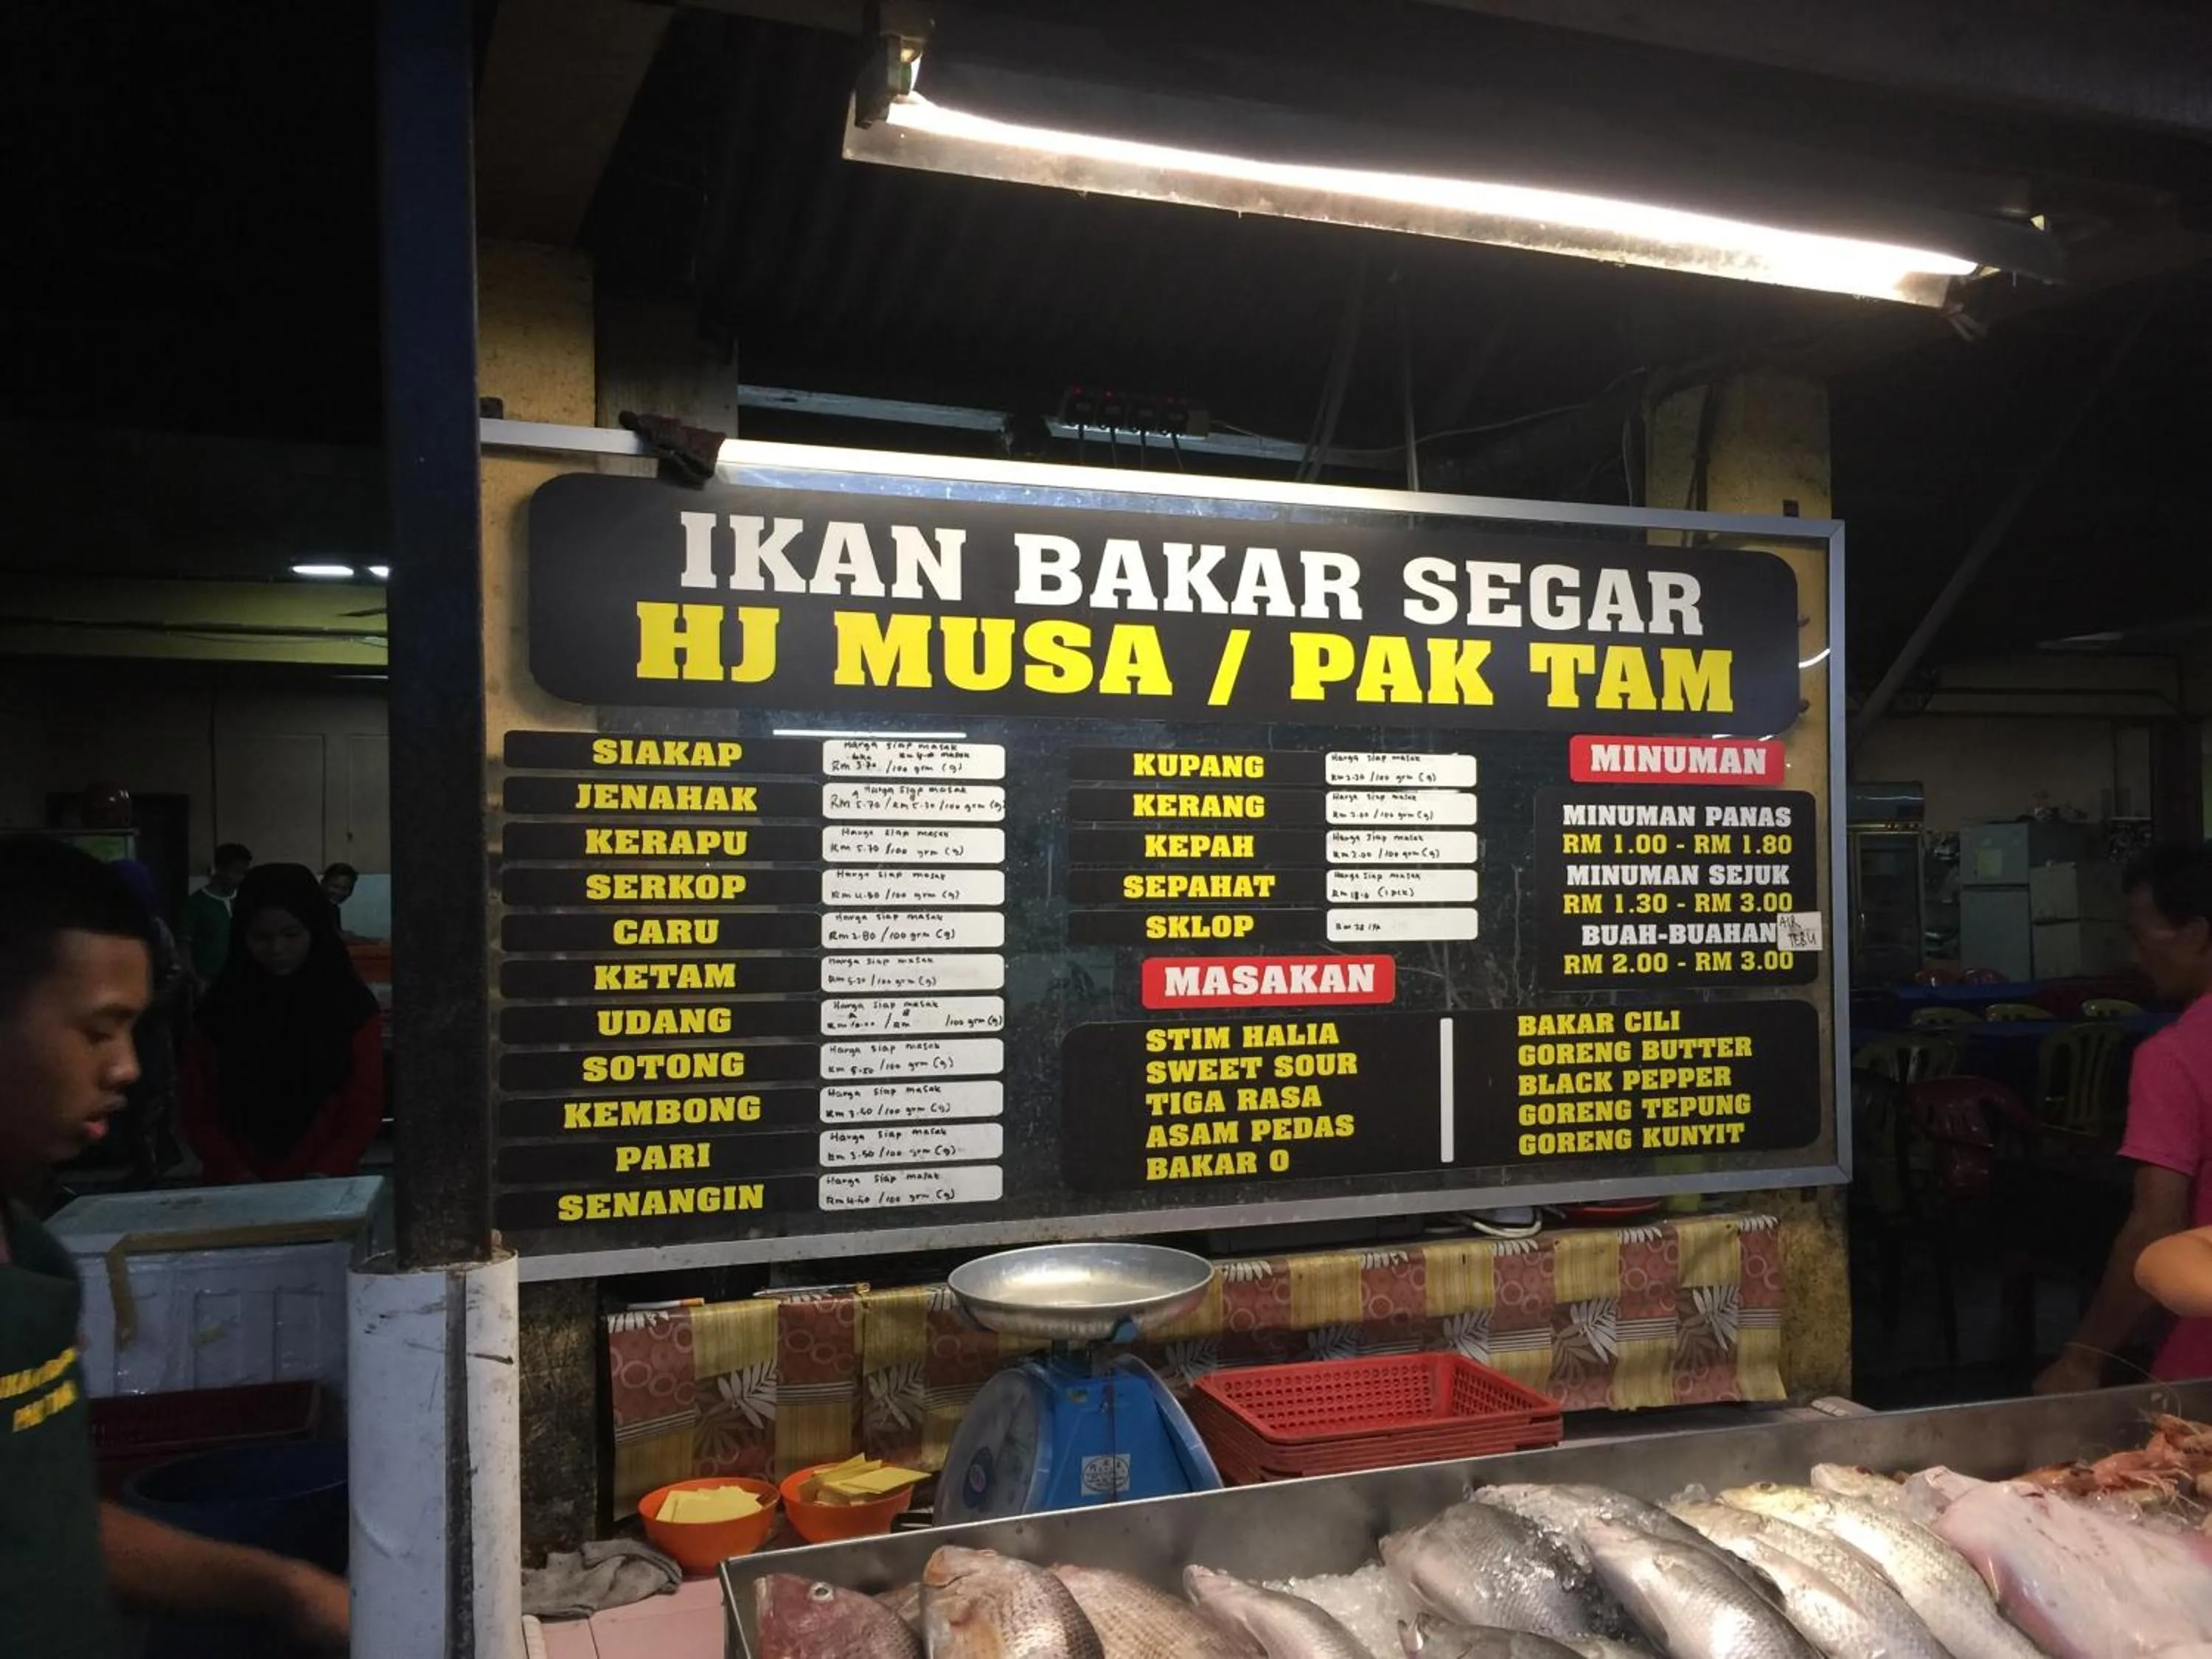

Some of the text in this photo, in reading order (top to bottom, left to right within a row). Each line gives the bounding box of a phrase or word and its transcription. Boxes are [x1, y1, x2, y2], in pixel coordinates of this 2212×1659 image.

[681, 511, 1703, 636] IKAN BAKAR SEGAR
[636, 601, 1733, 713] HJ MUSA / PAK TAM
[592, 738, 742, 768] SIAKAP
[1133, 752, 1265, 779] KUPANG
[1590, 744, 1766, 774] MINUMAN
[575, 783, 757, 812] JENAHAK
[1132, 793, 1265, 818] KERANG
[1562, 804, 1791, 827] MINUMAN PANAS
[585, 828, 748, 856] KERAPU
[1144, 834, 1255, 858] KEPAH
[1563, 833, 1602, 854] RM
[1615, 833, 1667, 855] 1.00
[1694, 834, 1731, 855] RM
[1743, 834, 1792, 855] 1.80
[586, 874, 747, 900] SERKOP
[1123, 874, 1276, 899] SEPAHAT
[1567, 864, 1790, 886] MINUMAN SEJUK
[1563, 893, 1603, 914] RM
[1615, 893, 1668, 914] 1.30
[1695, 893, 1732, 913] RM
[1740, 892, 1792, 913] 3.00
[613, 919, 720, 945] CARU
[1145, 914, 1254, 939] SKLOP
[1582, 922, 1776, 946] BUAH-BUAHAN
[594, 963, 736, 990] KETAM
[1564, 953, 1603, 975] RM
[1612, 952, 1668, 974] 2.00
[1695, 951, 1732, 971] RM
[1740, 950, 1793, 971] 3.00
[1164, 964, 1375, 996] MASAKAN
[597, 1007, 731, 1036] UDANG
[1517, 1010, 1680, 1037] BAKAR CILI
[1145, 1022, 1340, 1053] STIM HALIA
[1518, 1036, 1753, 1067] GORENG BUTTER
[582, 1051, 745, 1082] SOTONG
[1146, 1052, 1357, 1085] SWEET SOUR
[1518, 1065, 1731, 1096] BLACK PEPPER
[564, 1095, 761, 1129] KEMBONG
[1145, 1085, 1322, 1116] TIGA RASA
[1518, 1093, 1751, 1126] GORENG TEPUNG
[1146, 1114, 1354, 1148] ASAM PEDAS
[1518, 1122, 1745, 1155] GORENG KUNYIT
[616, 1142, 710, 1172] PARI
[1147, 1149, 1290, 1180] BAKAR O
[558, 1184, 765, 1221] SENANGIN
